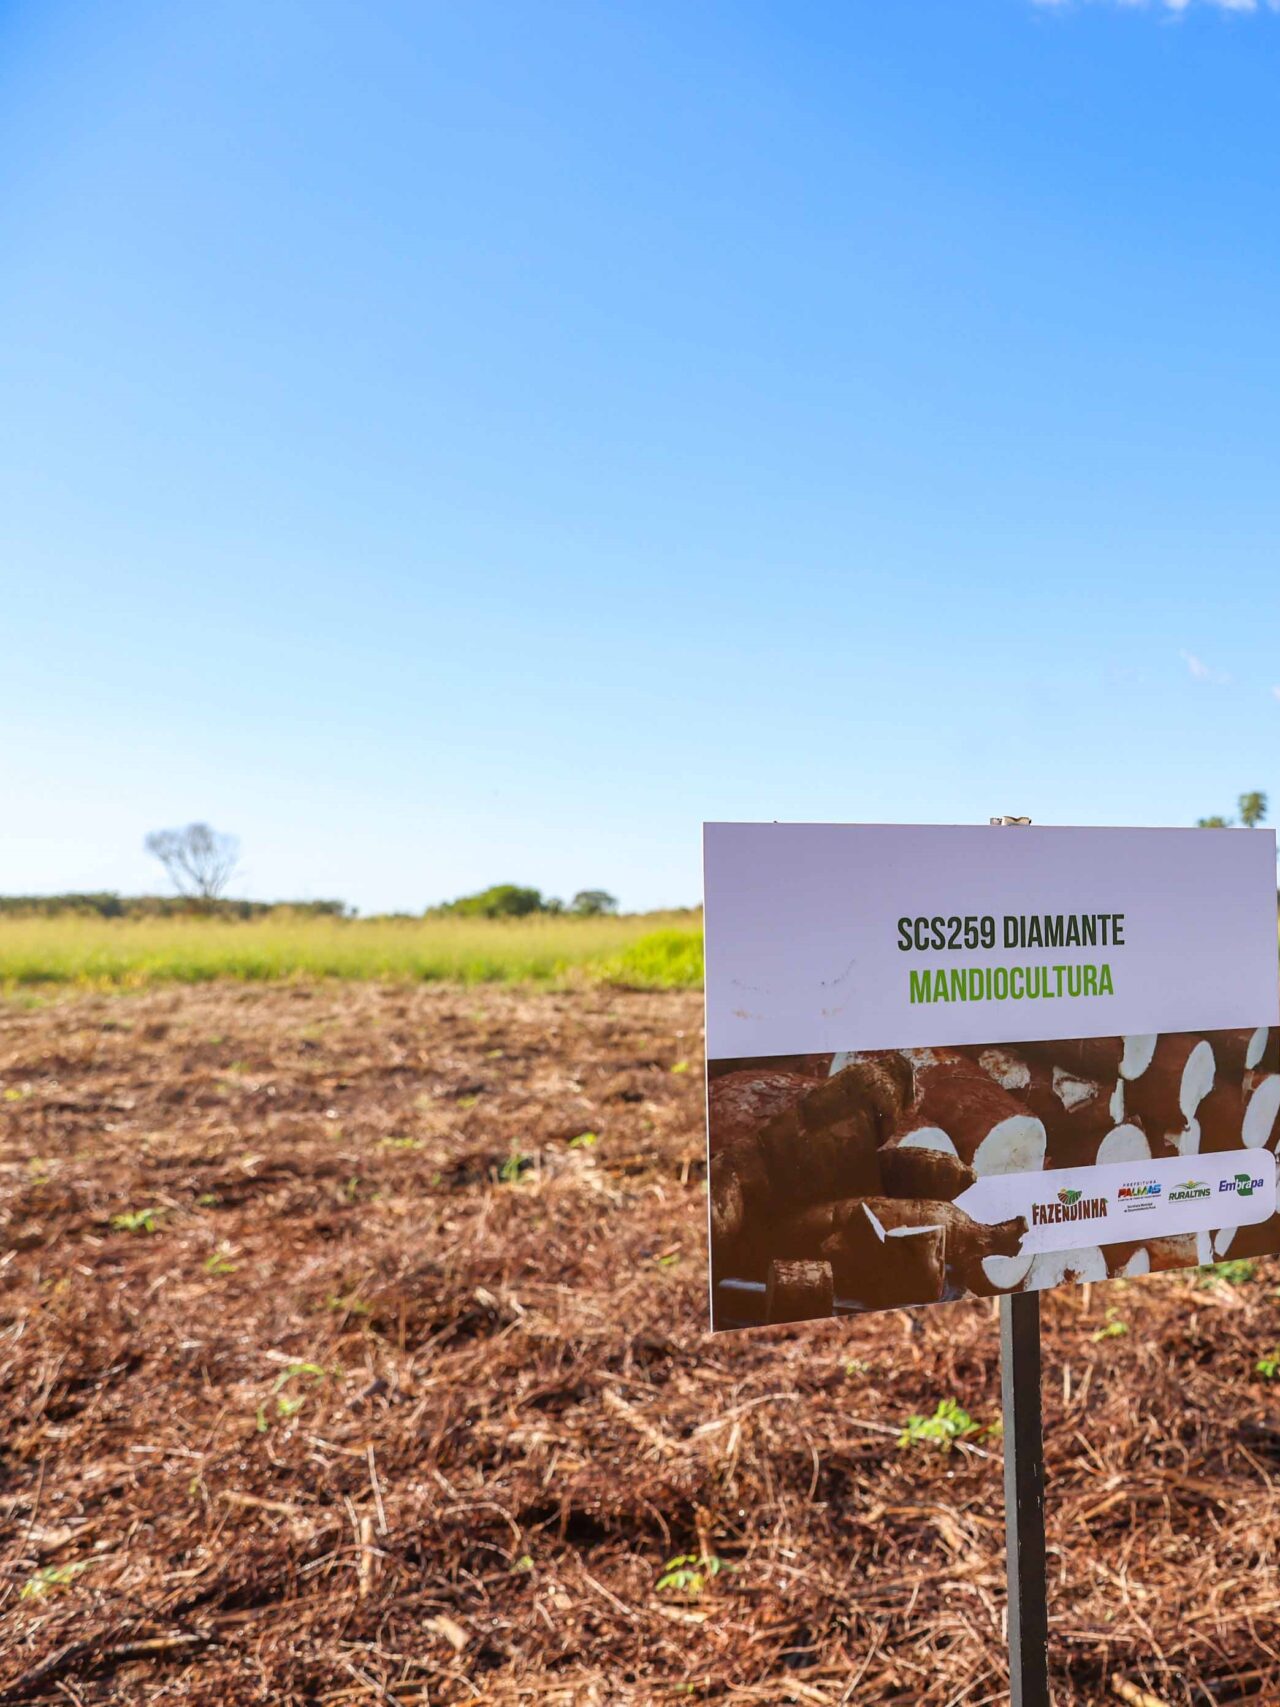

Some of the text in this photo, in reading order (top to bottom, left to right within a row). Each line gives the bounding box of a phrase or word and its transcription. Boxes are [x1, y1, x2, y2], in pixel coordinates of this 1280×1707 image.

[897, 914, 1125, 951] SCS259 DIAMANTE
[909, 964, 1114, 1004] MANDIOCULTURA
[1118, 1184, 1161, 1198] PALMAS
[1168, 1189, 1211, 1201] RURALTINS
[1219, 1178, 1264, 1192] Embrapa
[1032, 1198, 1108, 1225] FAZENDINHA
